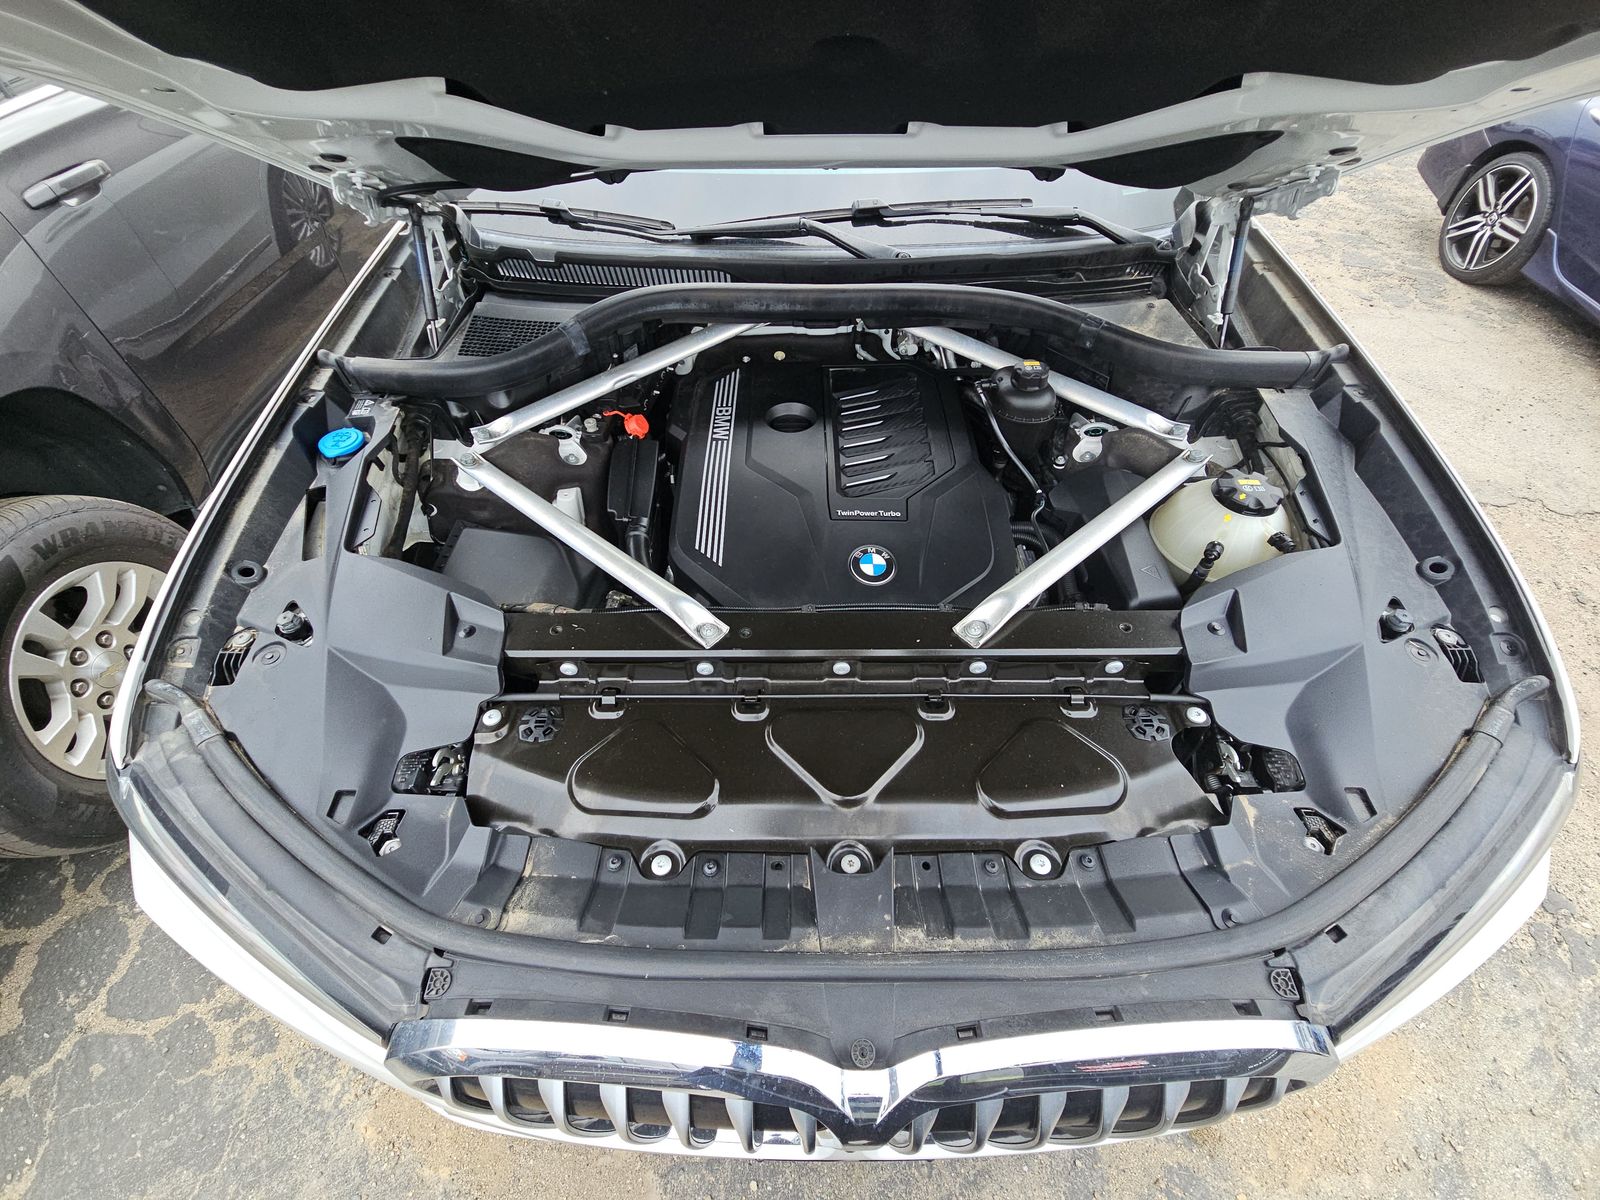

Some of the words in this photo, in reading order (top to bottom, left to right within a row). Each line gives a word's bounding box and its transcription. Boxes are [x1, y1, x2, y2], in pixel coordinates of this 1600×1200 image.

[712, 405, 733, 442] BMW
[836, 509, 878, 517] TwinPower
[878, 510, 902, 518] Turbo
